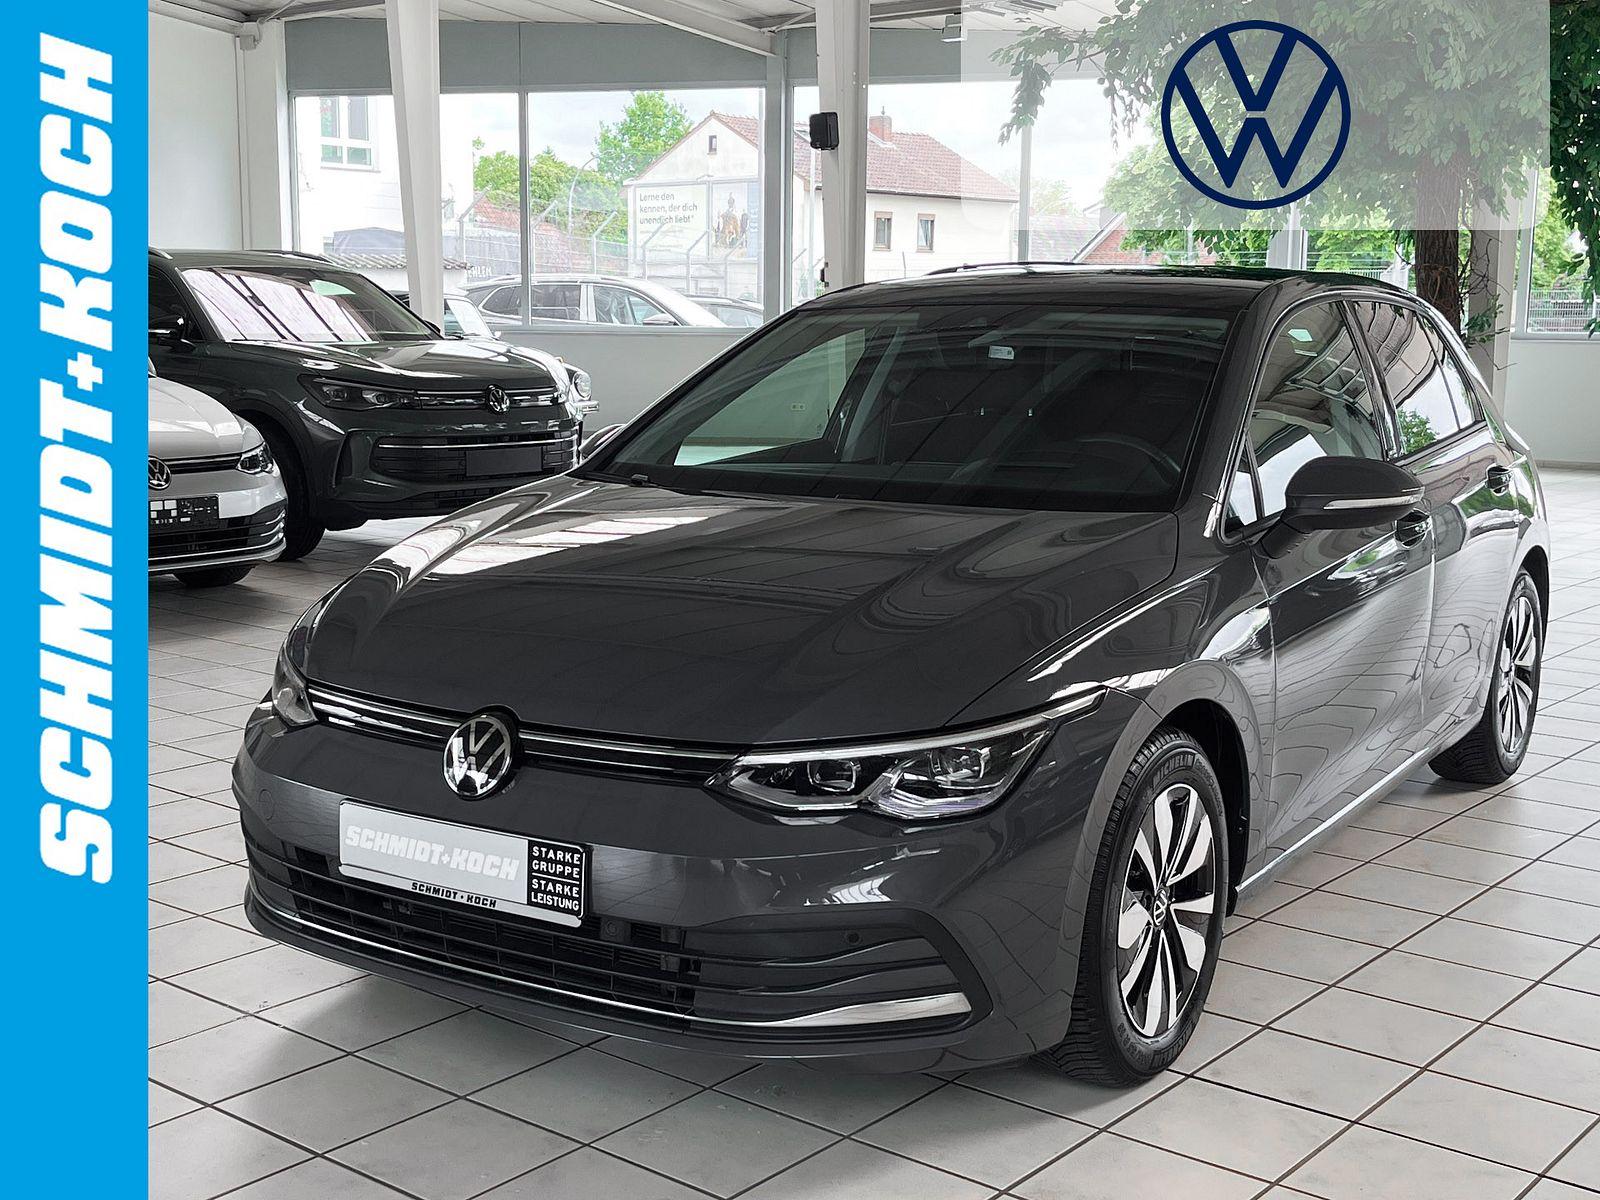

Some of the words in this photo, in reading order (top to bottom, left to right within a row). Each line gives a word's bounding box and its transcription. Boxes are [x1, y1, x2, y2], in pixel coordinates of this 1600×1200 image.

[639, 193, 660, 202] Lerne
[661, 193, 675, 201] den
[639, 204, 668, 214] kennen,
[669, 203, 681, 212] der
[682, 202, 698, 212] dich
[344, 824, 520, 881] SCHMIDT+KOCH
[532, 846, 581, 865] STARKE
[532, 859, 580, 879] GRUPPE
[411, 881, 458, 900] SCHMIDT
[466, 893, 497, 909] KOCH
[531, 878, 580, 898] STARKE
[531, 891, 580, 911] LEISTUNG
